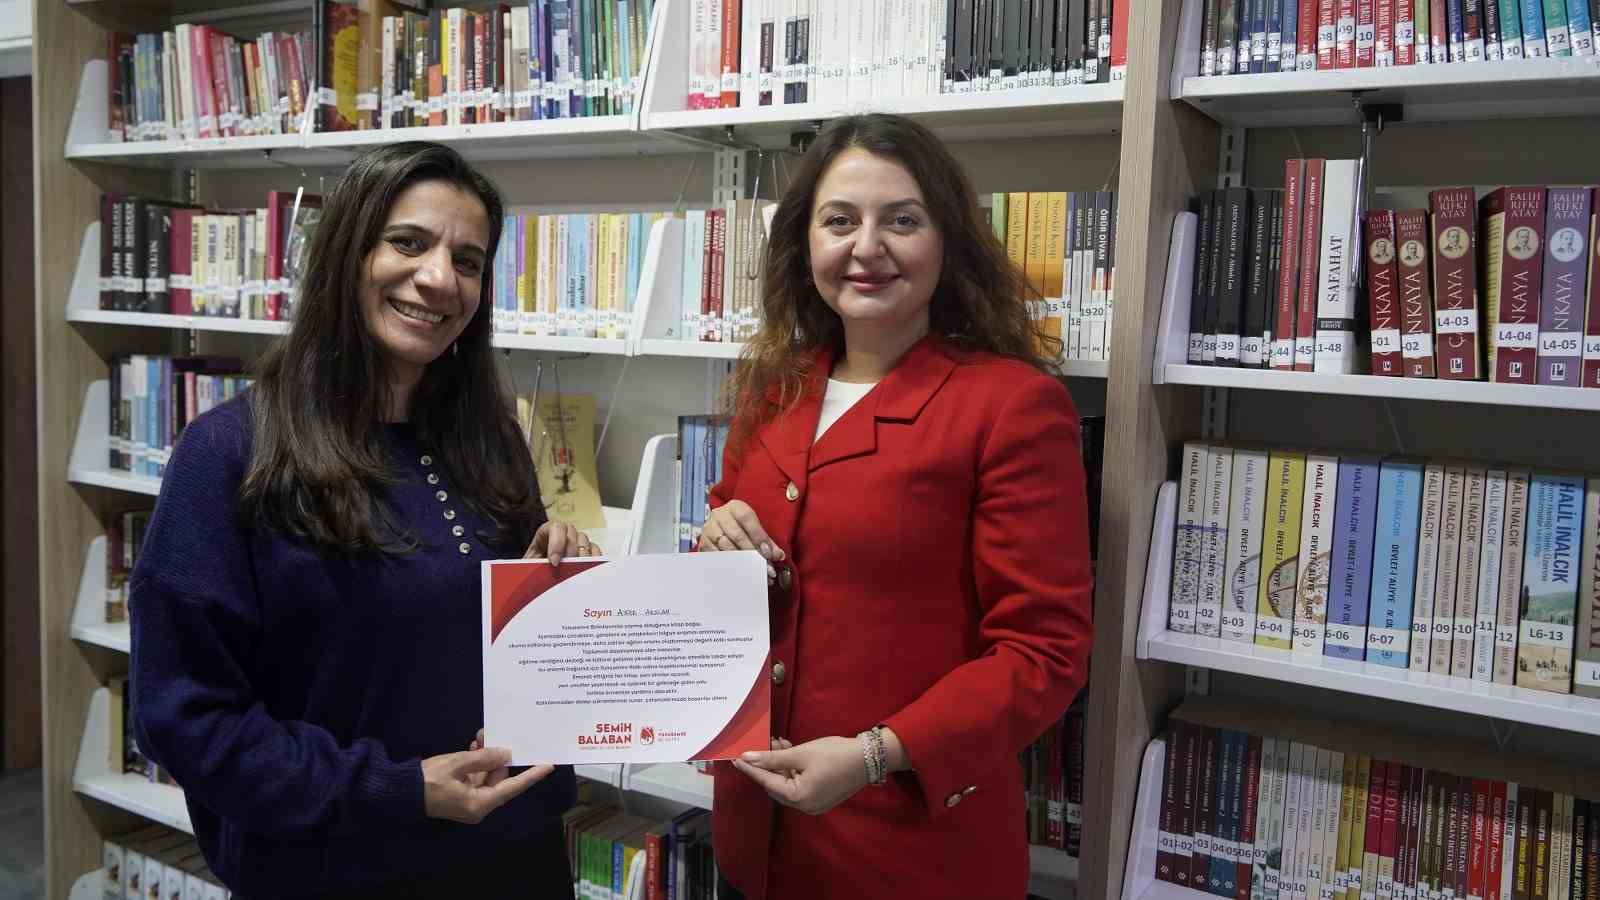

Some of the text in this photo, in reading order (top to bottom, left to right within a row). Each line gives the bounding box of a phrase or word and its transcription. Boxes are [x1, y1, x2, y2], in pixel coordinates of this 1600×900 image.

[1550, 34, 1565, 44] 22
[1441, 210, 1465, 218] ATAY
[1511, 209, 1537, 217] ATAY
[1554, 210, 1583, 219] ATAY
[1098, 234, 1107, 260] DİVAN
[1328, 235, 1343, 303] SAFAHAT
[1405, 271, 1423, 334] NKAYA
[1553, 271, 1574, 330] NKAYA
[1447, 269, 1465, 349] ÇKAYA
[1438, 316, 1469, 327] L4-03
[1371, 337, 1390, 346] -01
[1499, 331, 1532, 341] L4-04
[1314, 343, 1342, 352] 1-48
[1402, 342, 1420, 351] -02
[1543, 339, 1577, 350] L4-05
[1315, 464, 1324, 490] HALİL
[1311, 492, 1322, 528] İNALCIK
[1552, 482, 1577, 585] HALİL İNALCIK
[583, 608, 612, 619] Sayın
[1222, 616, 1245, 627] 6-03
[1293, 628, 1317, 639] 6-05
[1529, 627, 1565, 641] L6-13
[596, 722, 632, 732] SEMİH
[578, 734, 632, 745] BALABAN
[1379, 882, 1391, 891] 16
